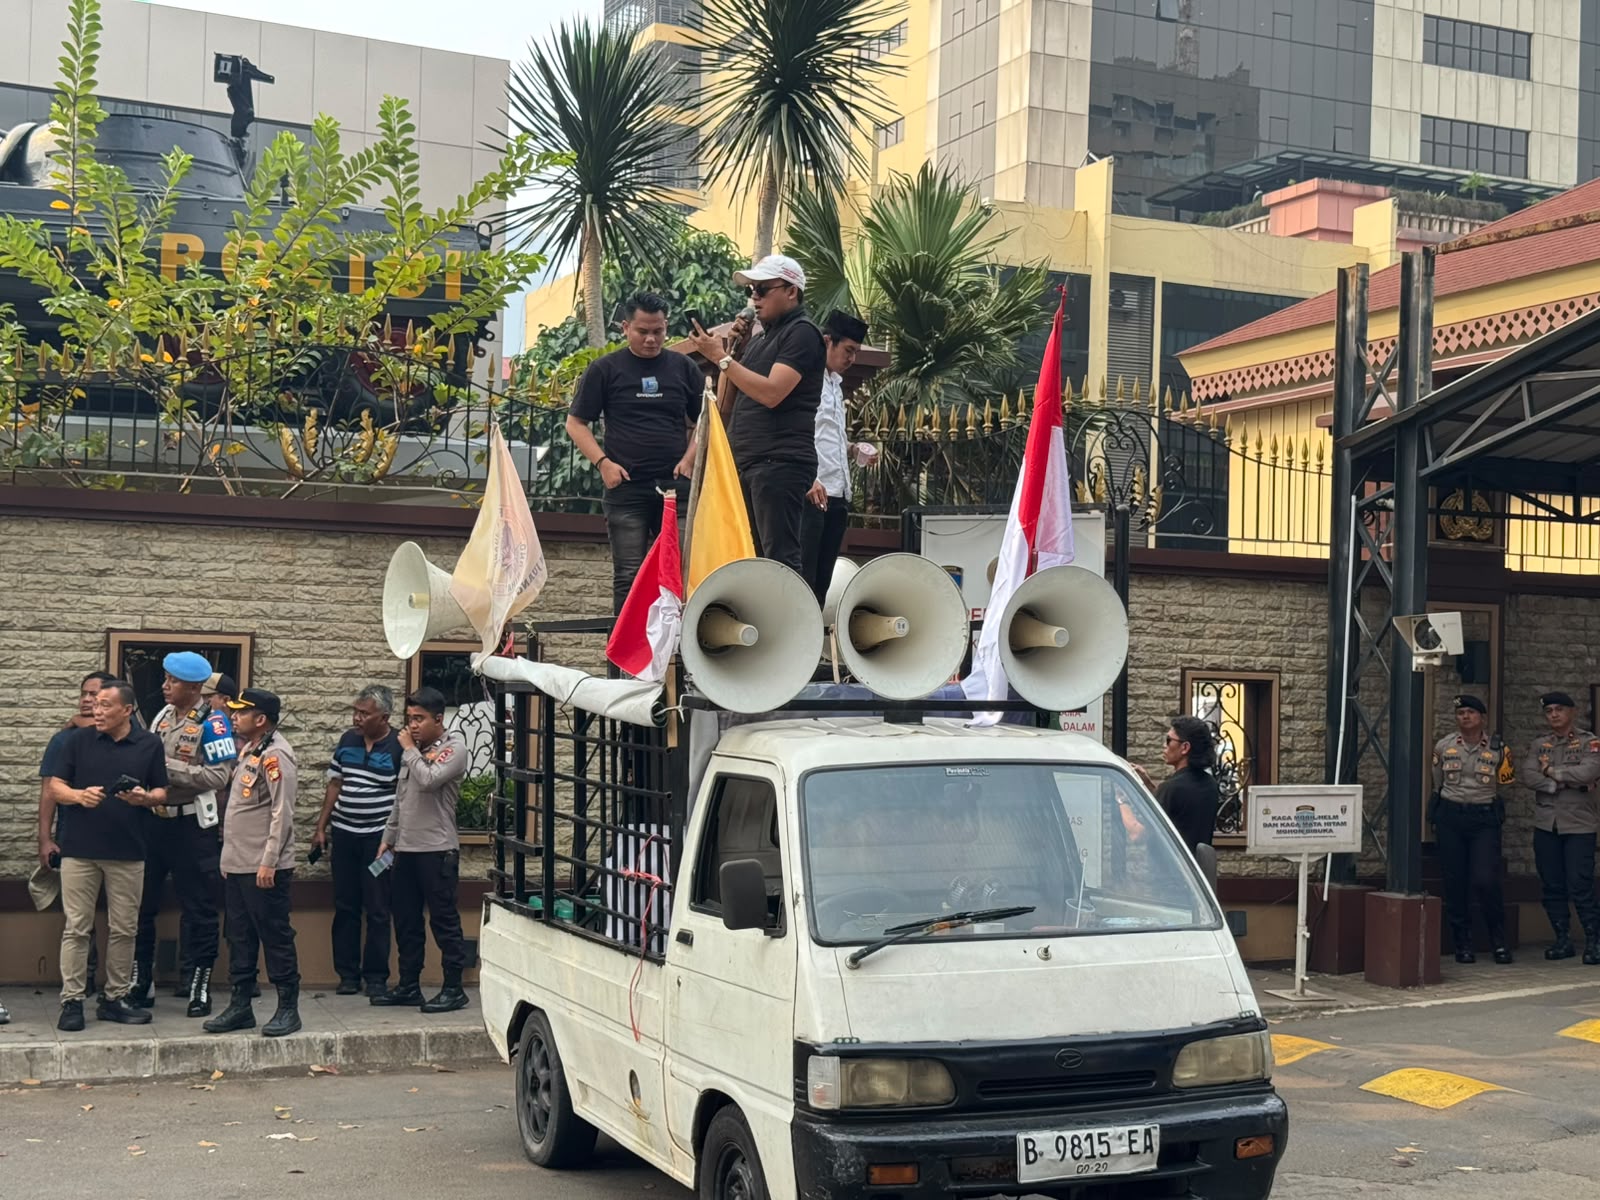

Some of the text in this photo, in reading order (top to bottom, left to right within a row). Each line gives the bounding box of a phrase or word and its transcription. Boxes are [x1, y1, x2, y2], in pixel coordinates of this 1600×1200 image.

[1063, 722, 1096, 731] DALAM
[1024, 1138, 1038, 1165] B
[1055, 1132, 1111, 1162] 9815
